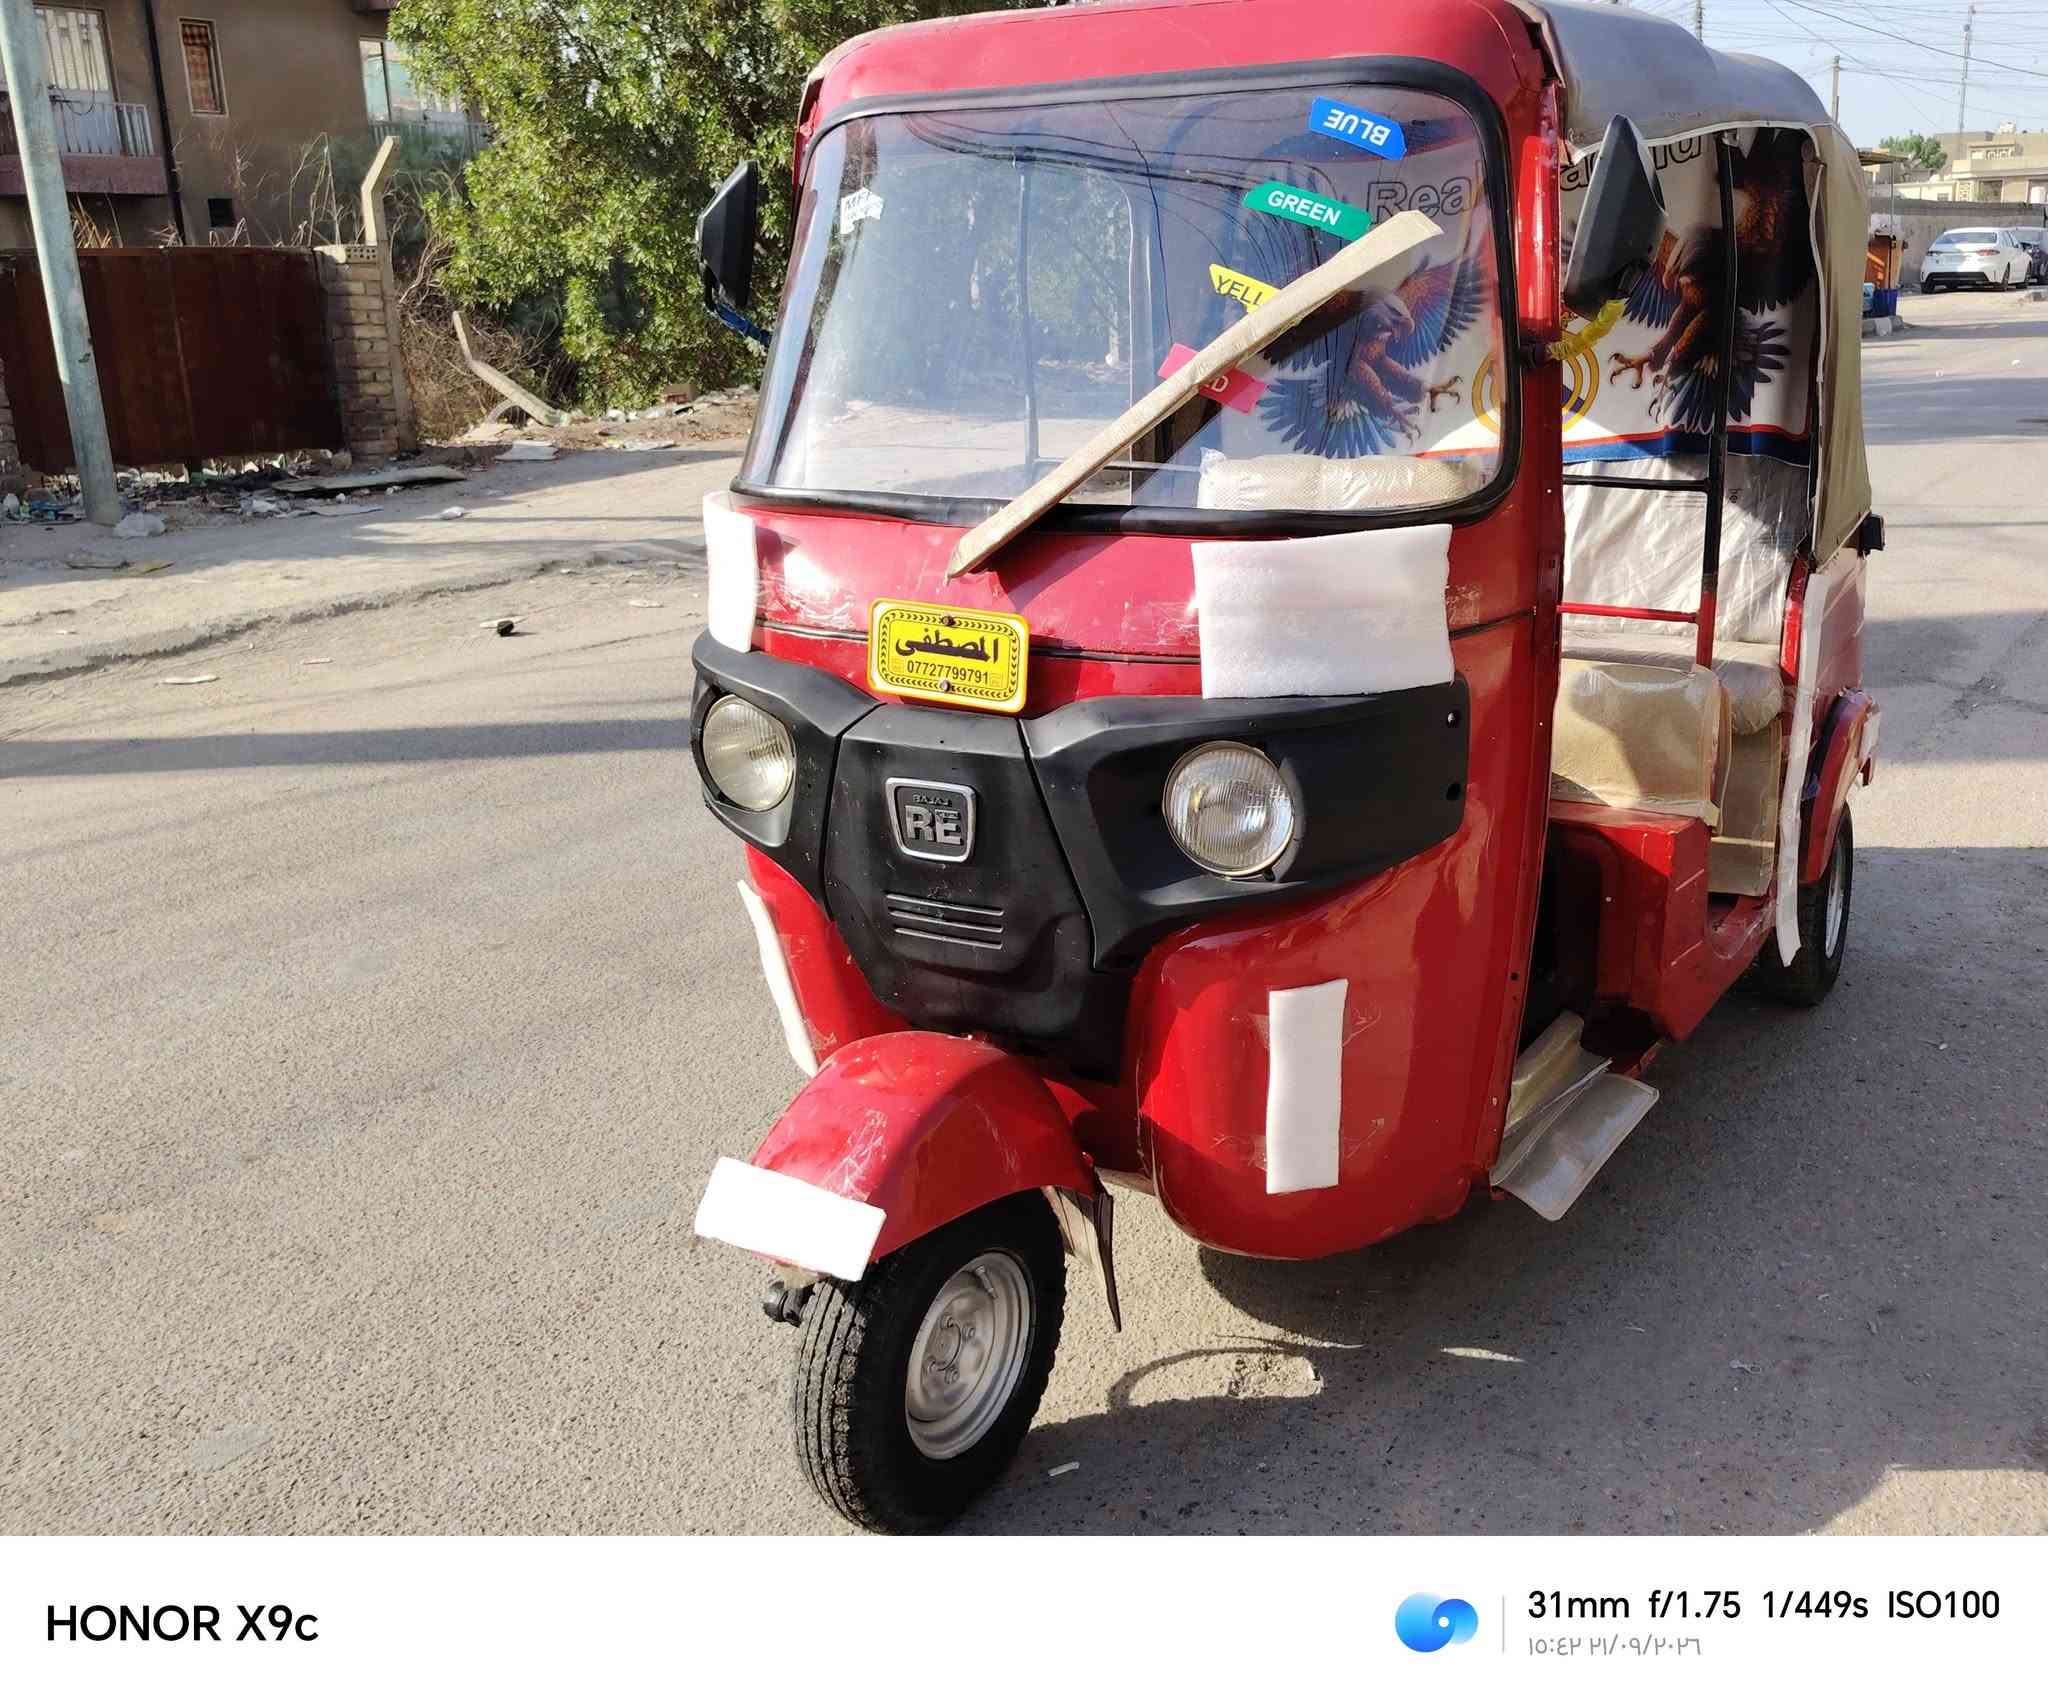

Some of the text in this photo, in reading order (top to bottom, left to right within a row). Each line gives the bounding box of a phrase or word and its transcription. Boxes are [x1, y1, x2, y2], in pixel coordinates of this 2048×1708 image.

[1323, 108, 1391, 147] BLUE
[1268, 190, 1341, 226] GREEN
[1366, 172, 1480, 225] Rea
[1216, 274, 1263, 305] YELL
[896, 628, 999, 664] المصطفى
[907, 659, 989, 685] 07727799791
[905, 805, 962, 845] RE
